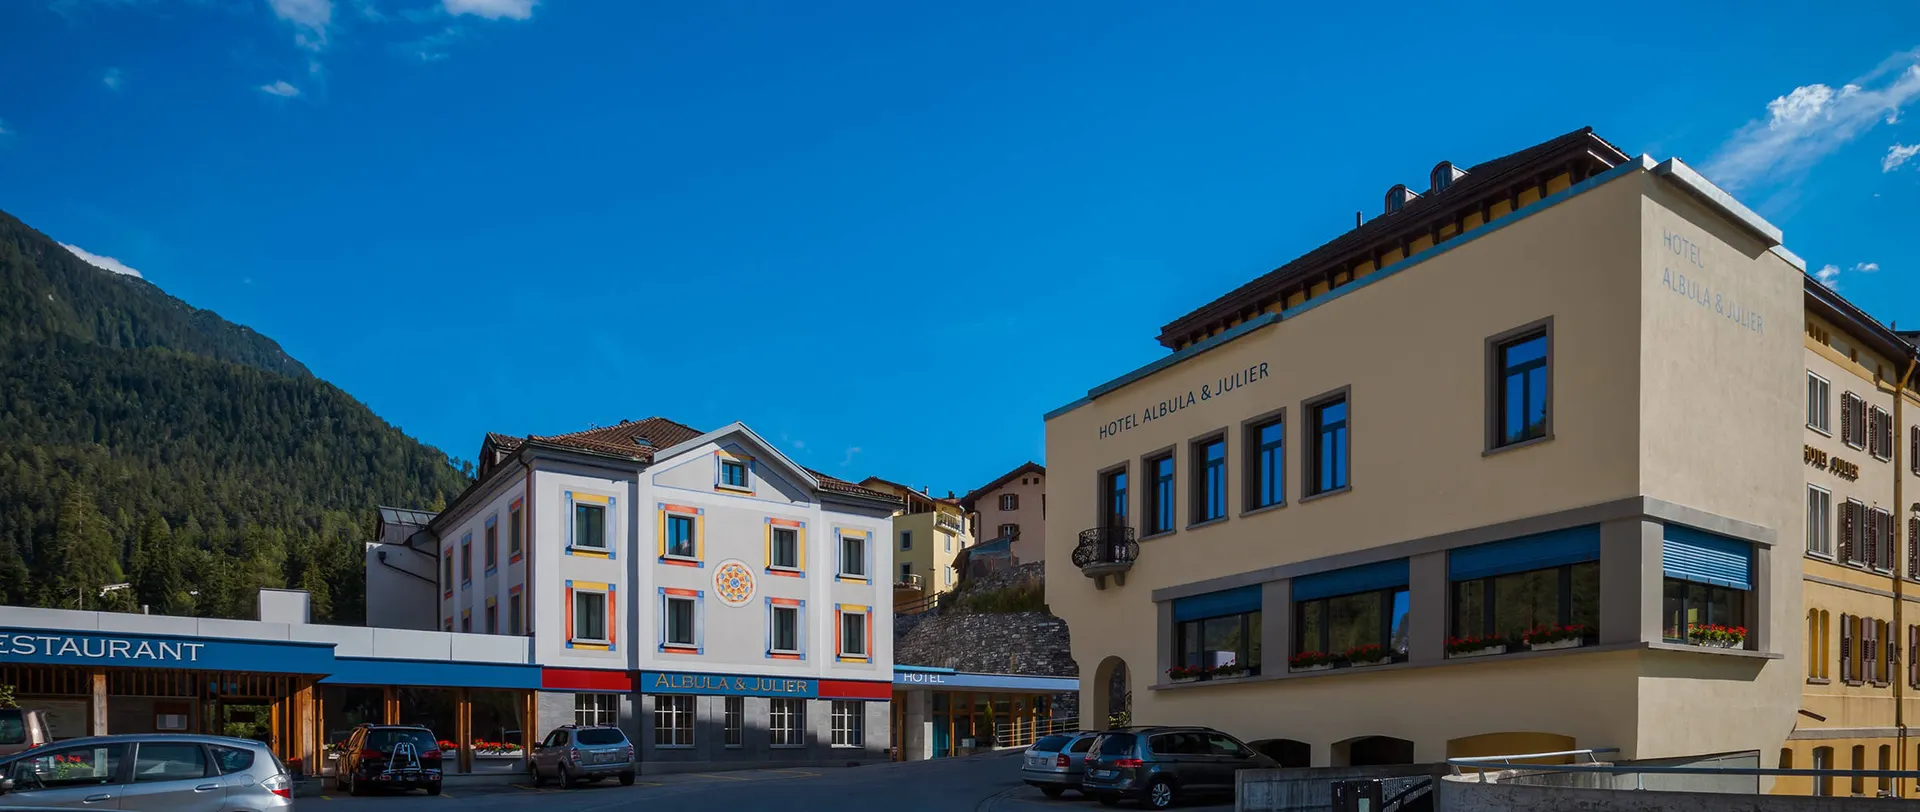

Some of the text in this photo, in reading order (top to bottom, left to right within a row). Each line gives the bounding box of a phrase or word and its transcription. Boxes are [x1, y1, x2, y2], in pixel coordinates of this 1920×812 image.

[1663, 228, 1704, 269] HOTEL
[1662, 267, 1764, 335] ALBULA & JULIER
[1099, 361, 1269, 440] HOTEL ALBULA & JULIER
[1804, 444, 1860, 480] HOTEL JULIER
[655, 672, 808, 693] ALBULA & JULIER
[903, 672, 945, 683] HOTEL
